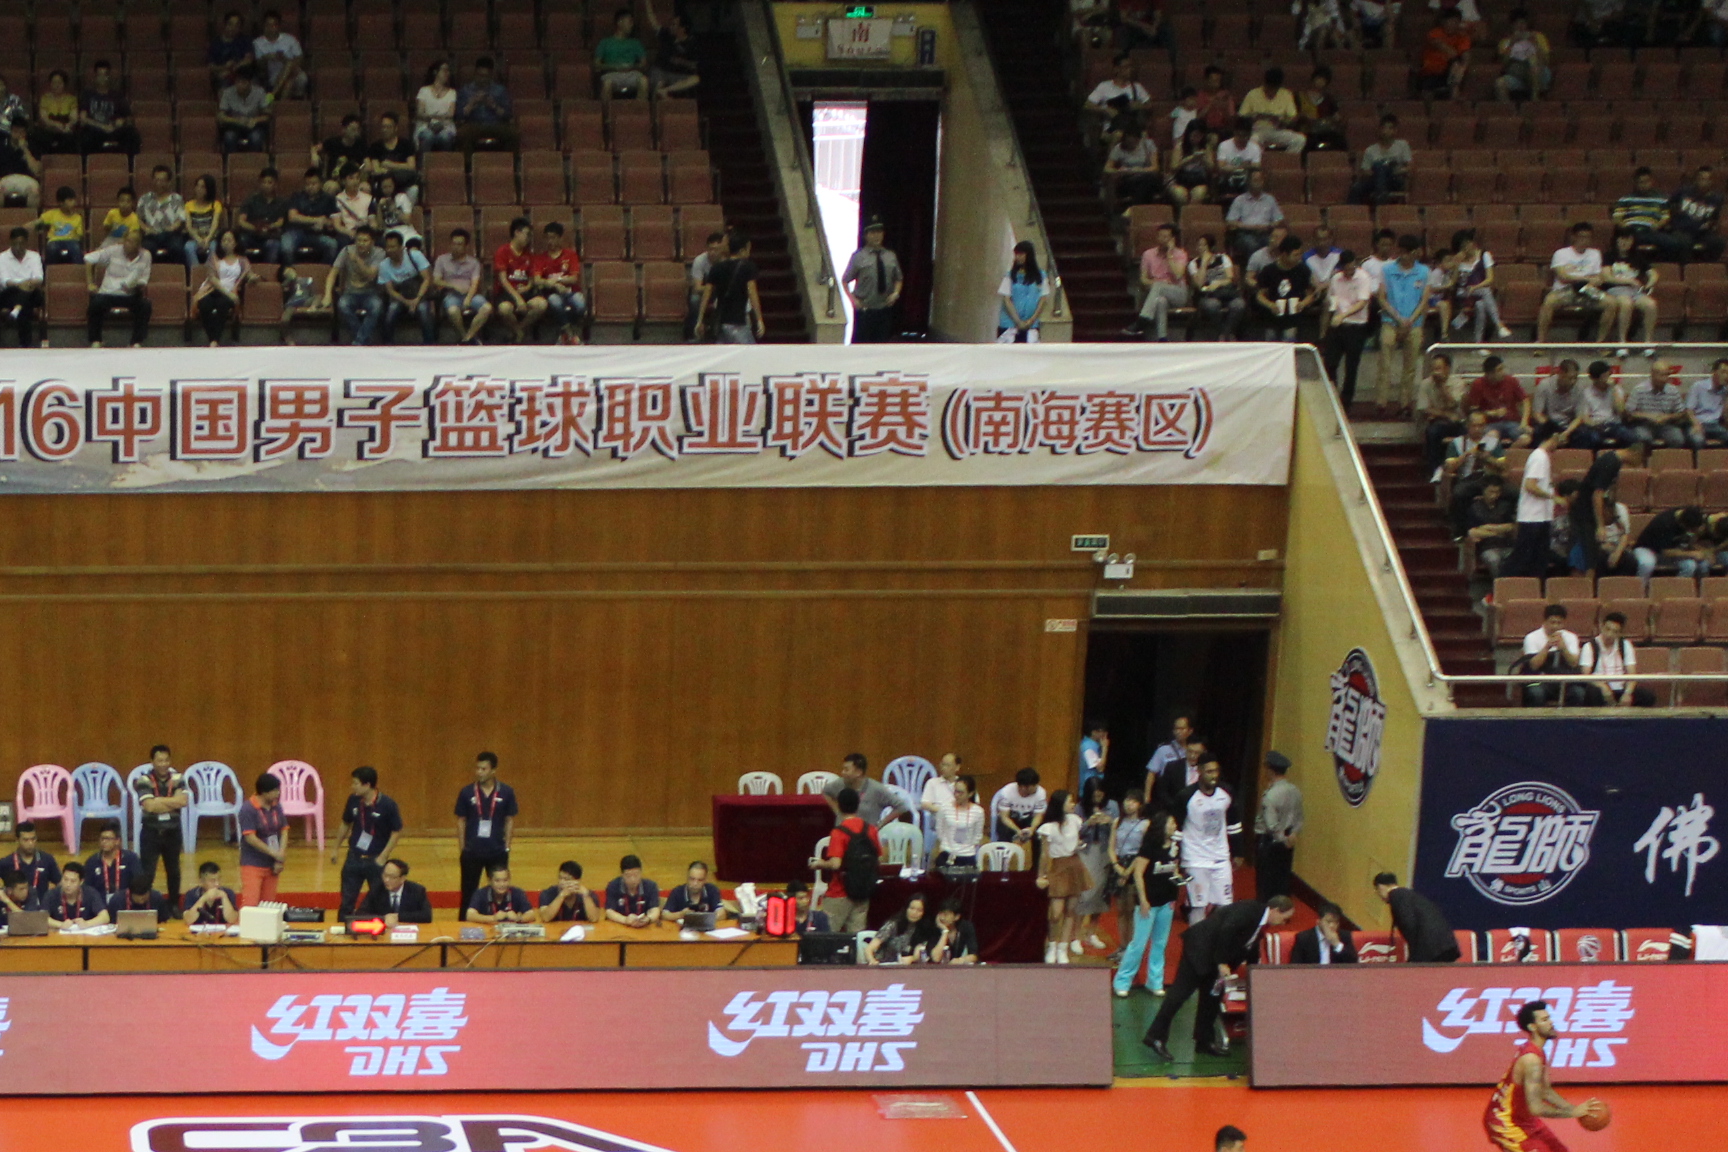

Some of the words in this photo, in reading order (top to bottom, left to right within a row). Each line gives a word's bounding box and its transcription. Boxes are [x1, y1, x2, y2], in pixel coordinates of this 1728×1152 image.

[1502, 791, 1534, 807] LONG
[1535, 793, 1567, 814] LIONS
[1632, 792, 1720, 897] 佛
[253, 988, 469, 1050] 红双喜
[710, 984, 925, 1047] 红双喜
[344, 1045, 461, 1076] DHS
[801, 1041, 918, 1072] DHS
